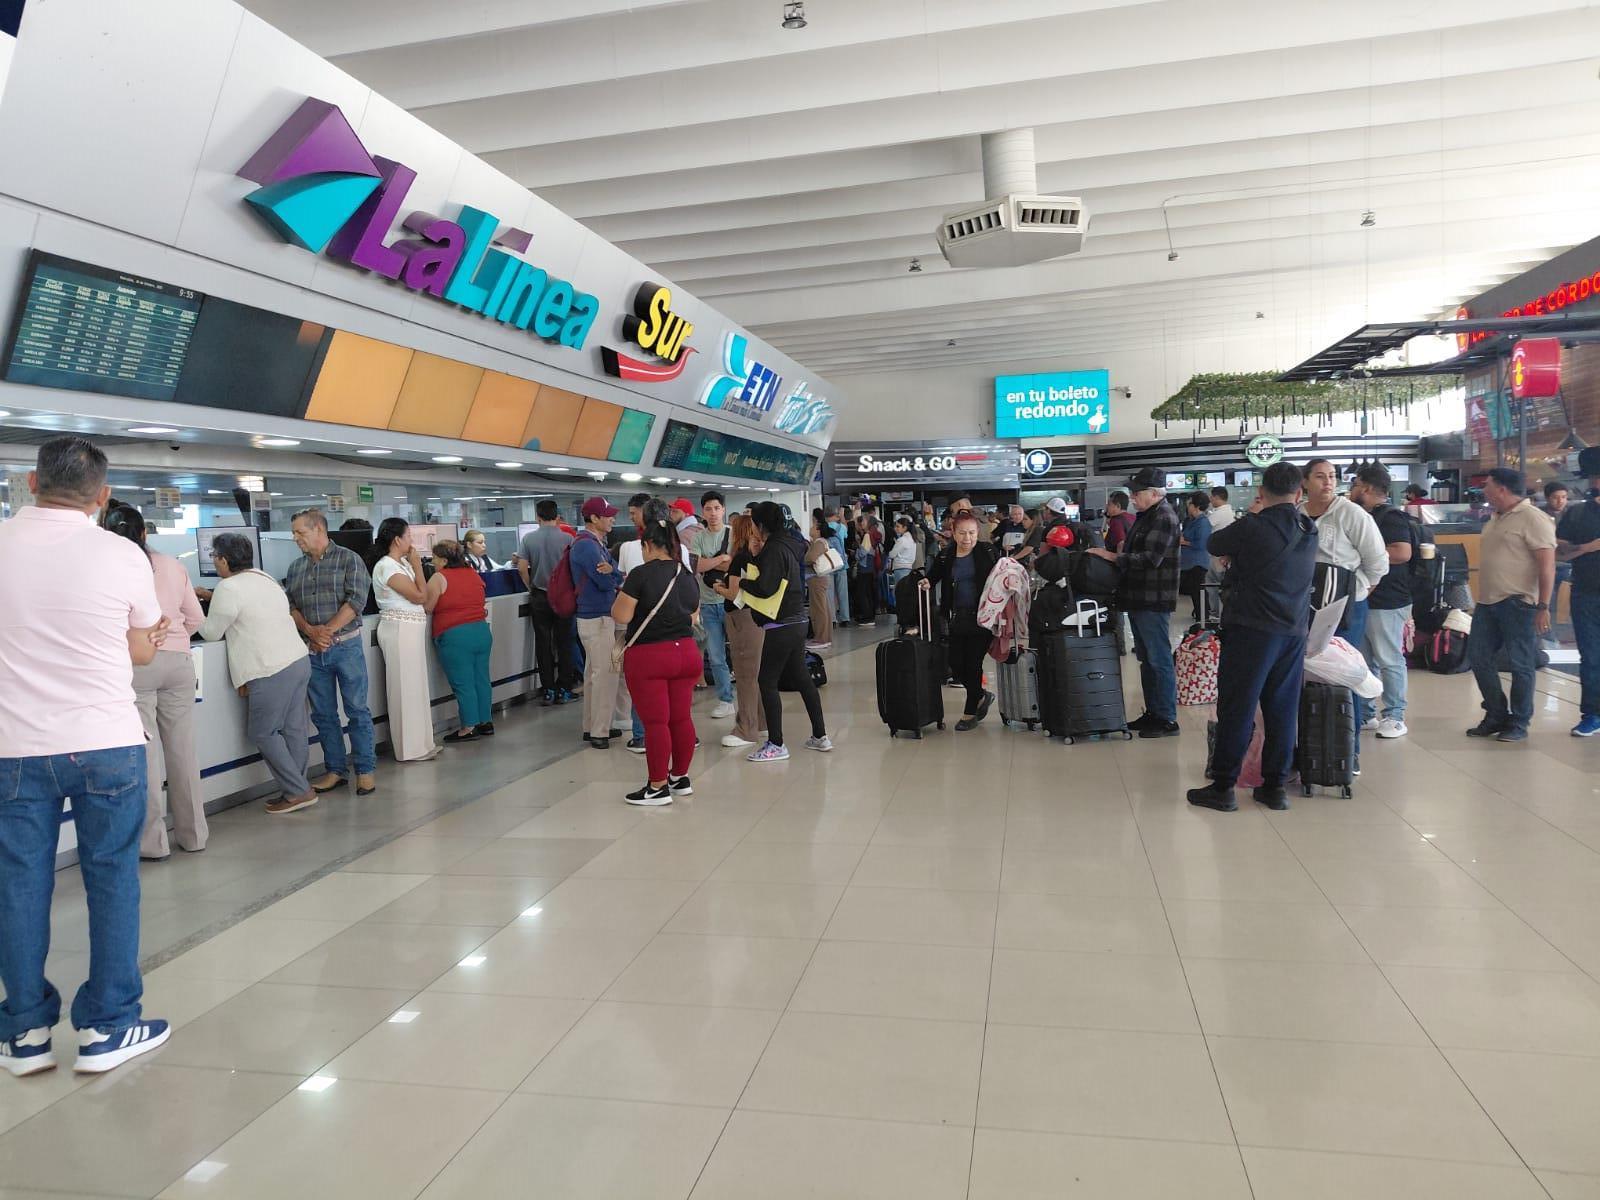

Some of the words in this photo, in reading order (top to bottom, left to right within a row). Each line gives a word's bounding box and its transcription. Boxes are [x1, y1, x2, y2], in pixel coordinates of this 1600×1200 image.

[636, 286, 695, 363] Sur
[740, 361, 783, 412] ETN
[1006, 391, 1026, 404] en
[1029, 389, 1046, 403] tu
[1048, 385, 1099, 402] boleto
[1015, 400, 1090, 419] redondo
[857, 454, 914, 473] Snack
[913, 457, 927, 471] &
[929, 455, 957, 471] GO
